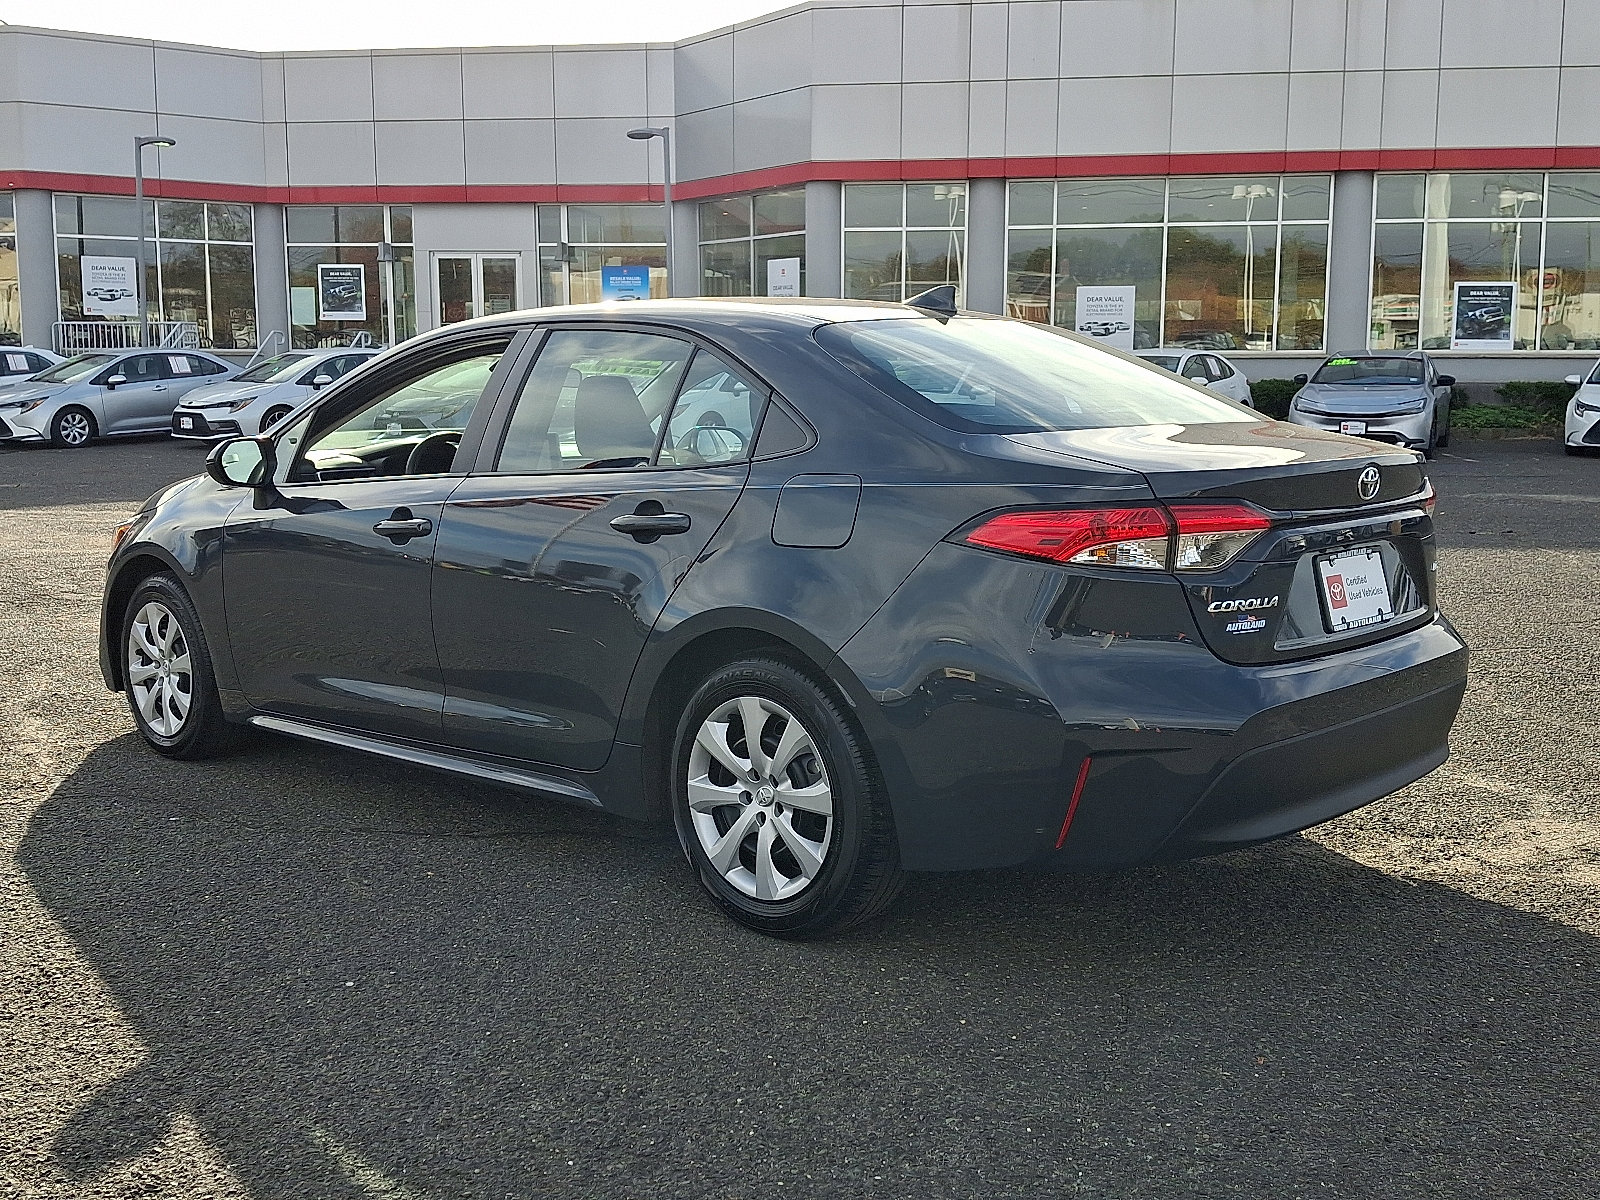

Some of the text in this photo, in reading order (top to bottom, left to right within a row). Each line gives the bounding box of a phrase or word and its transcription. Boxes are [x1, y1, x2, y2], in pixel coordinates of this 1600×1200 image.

[1345, 575, 1368, 587] Certified
[1348, 586, 1384, 601] Used Vehicles
[1207, 595, 1279, 613] COROLLA
[1225, 619, 1266, 632] AUTOLAND
[1348, 614, 1382, 629] AUTOLAND
